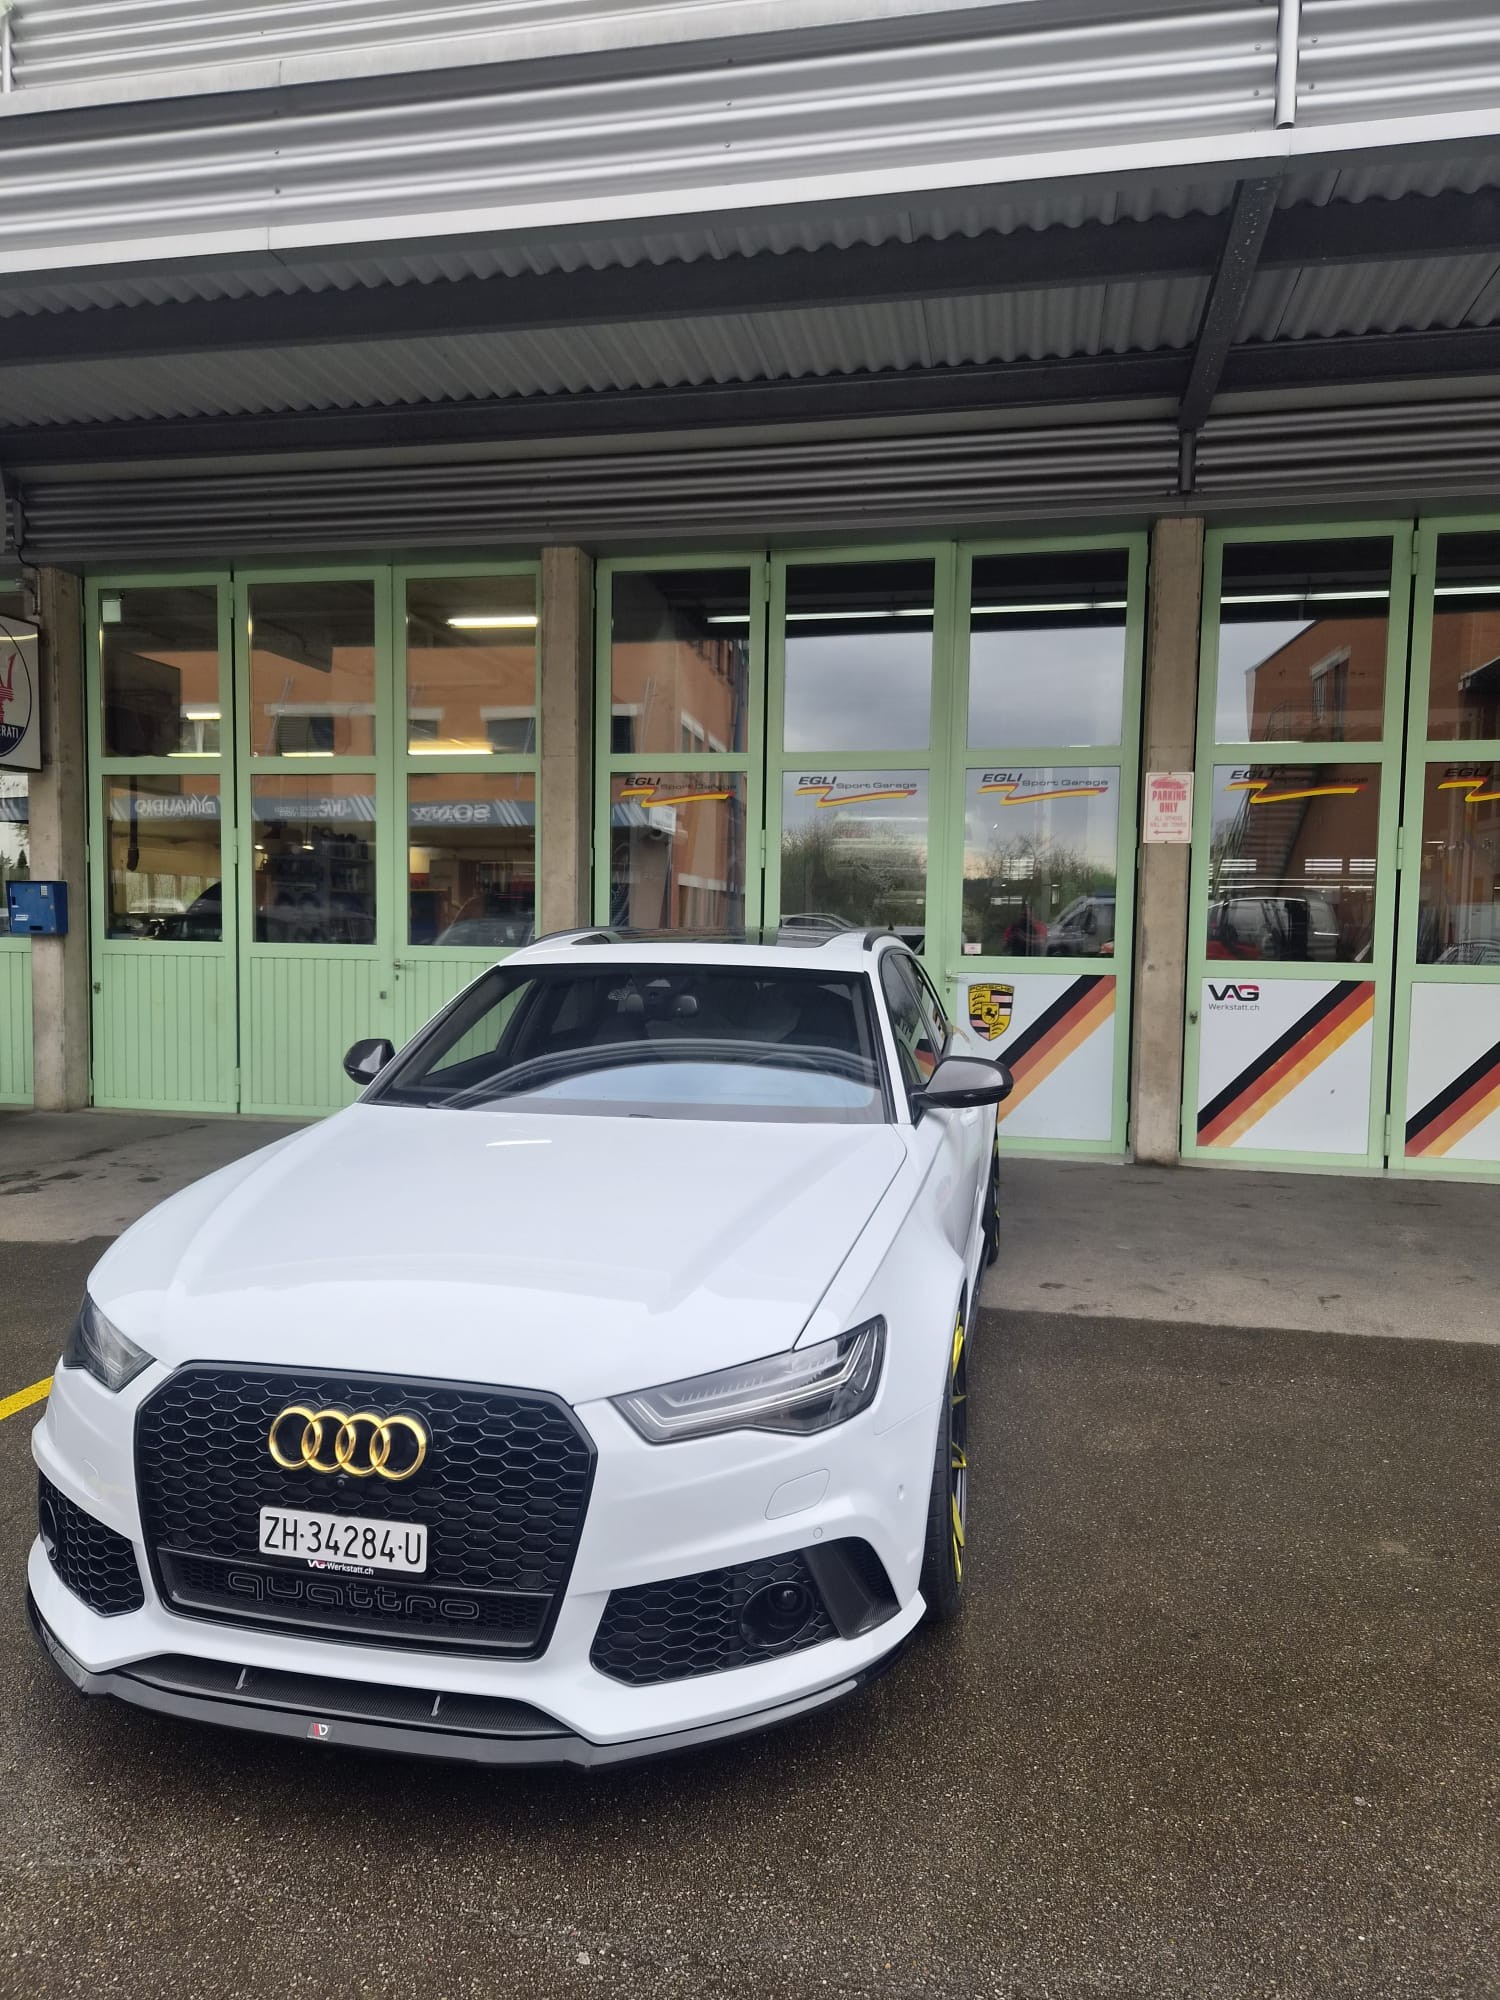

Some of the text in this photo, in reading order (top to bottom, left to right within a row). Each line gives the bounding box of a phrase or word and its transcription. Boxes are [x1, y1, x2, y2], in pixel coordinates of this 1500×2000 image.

[1230, 769, 1275, 779] EGLI
[1443, 767, 1491, 777] EGLI
[624, 777, 661, 786] EGLI
[798, 776, 837, 785] EGLI
[836, 782, 871, 790] Sport
[981, 773, 1023, 782] EGLI
[1061, 779, 1108, 787] Garage
[1152, 790, 1186, 800] PARKING
[1159, 802, 1178, 813] ONLY
[1208, 984, 1260, 1001] VAG
[1208, 1003, 1260, 1011] Werkstatt.ch
[228, 1571, 480, 1620] quattro
